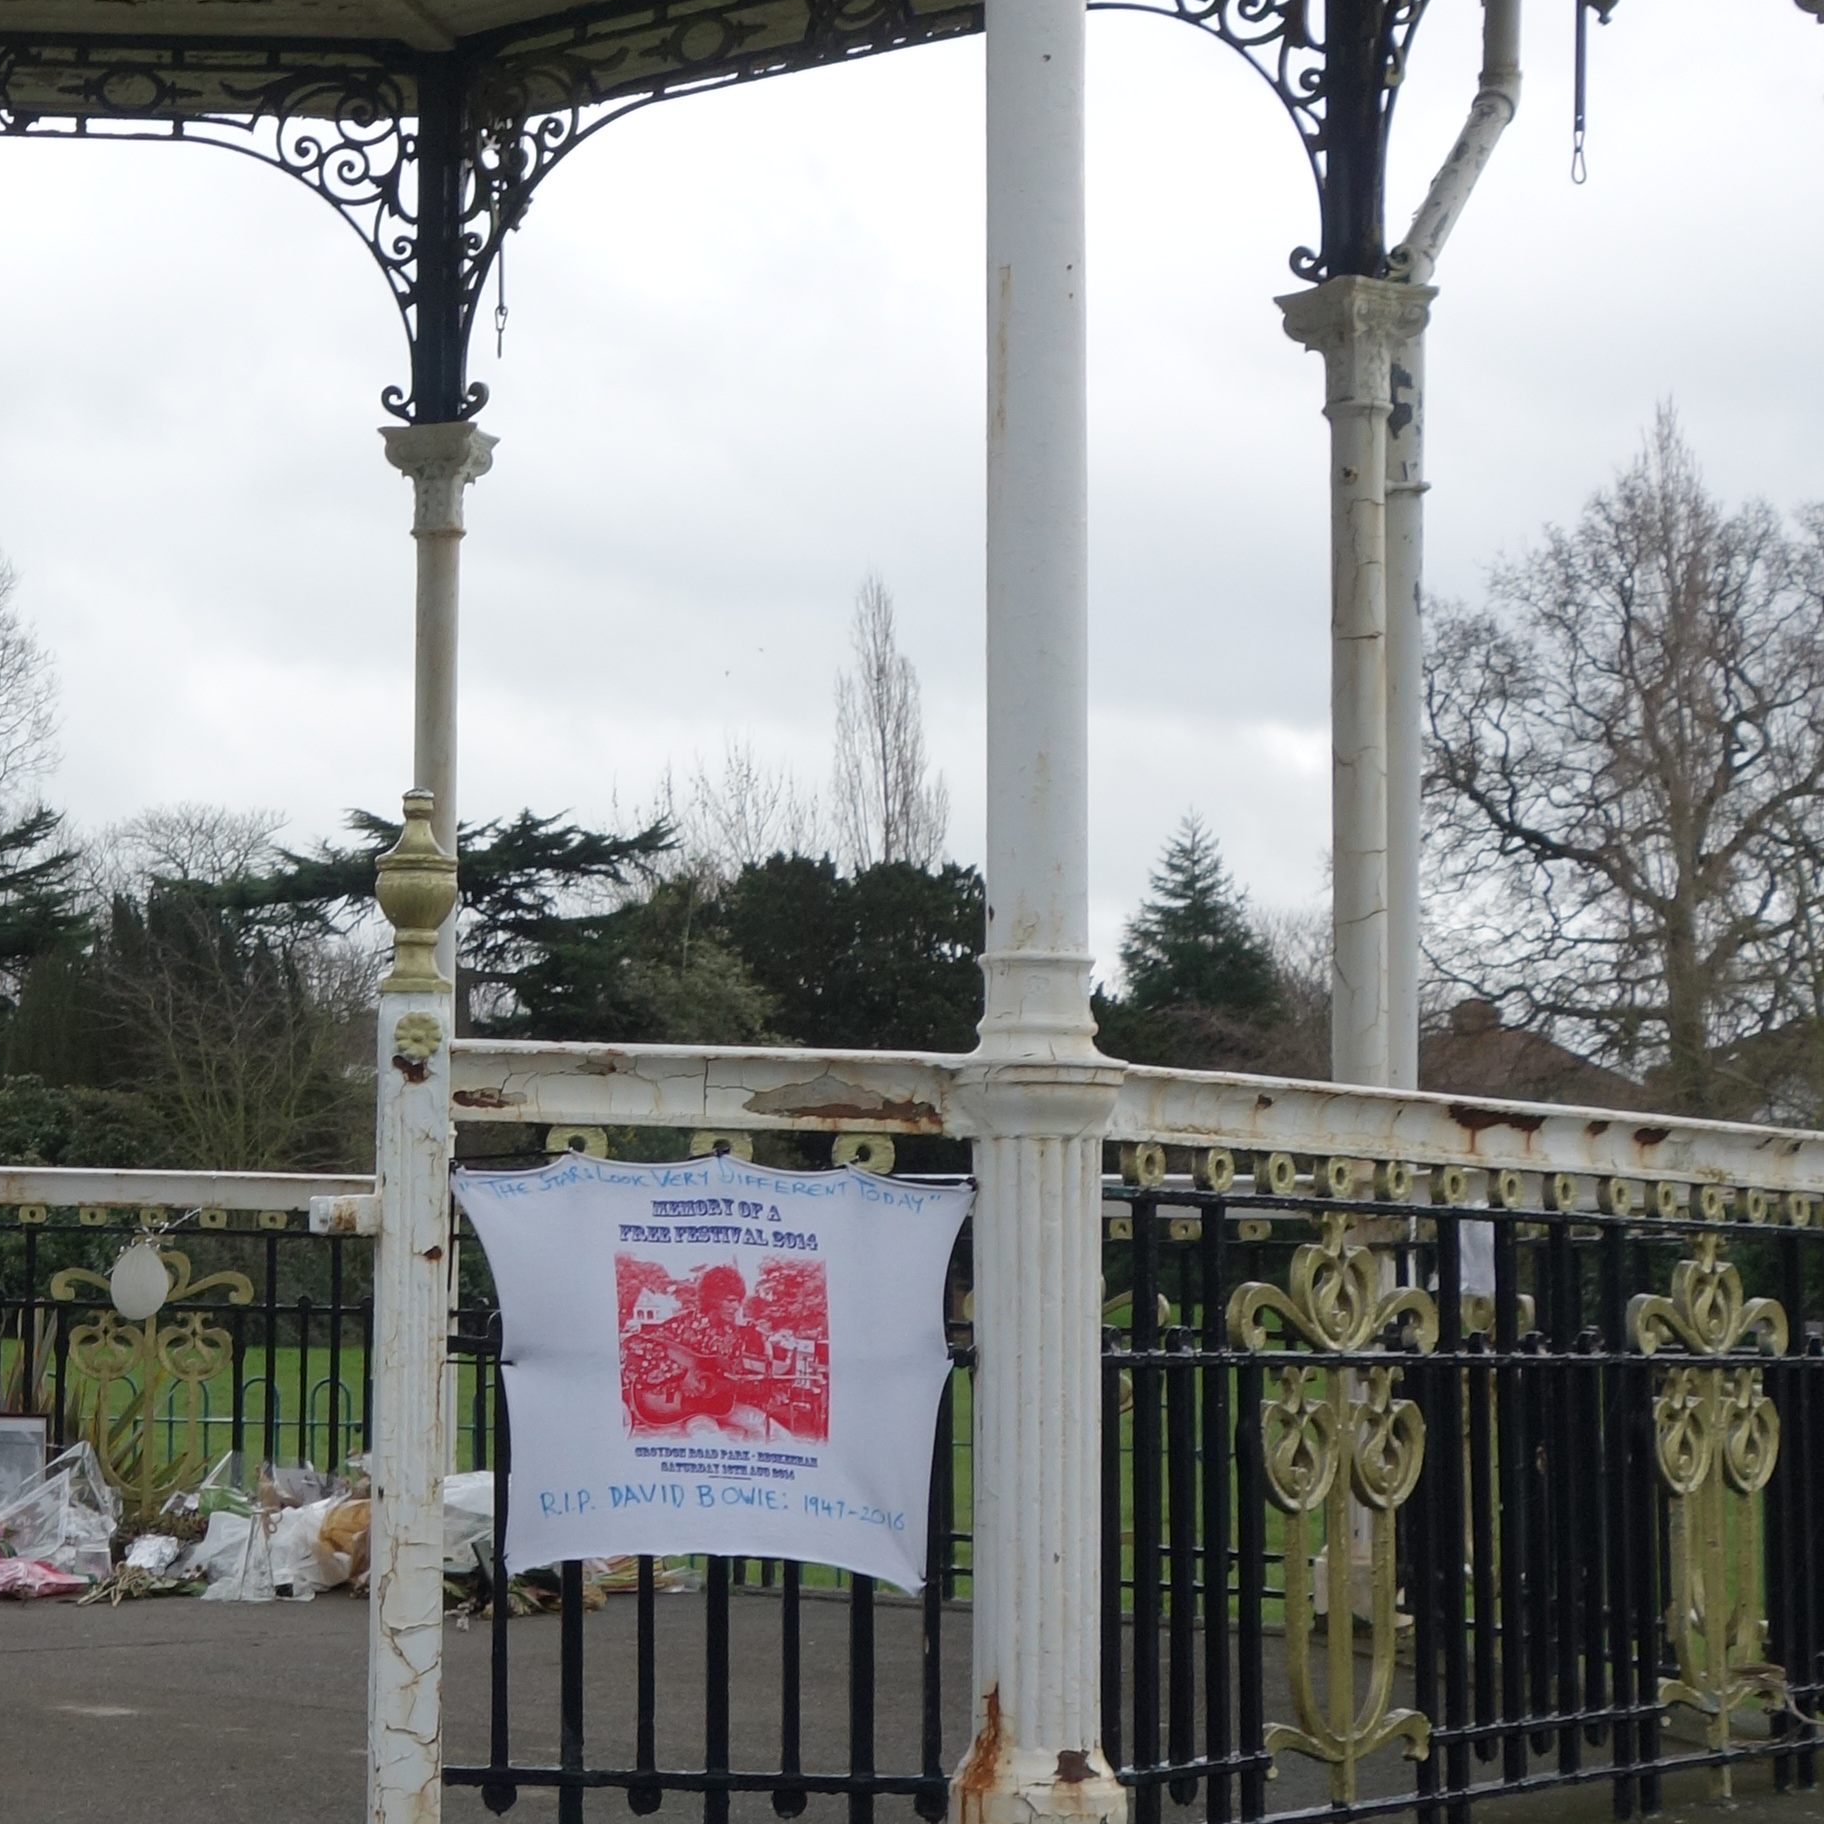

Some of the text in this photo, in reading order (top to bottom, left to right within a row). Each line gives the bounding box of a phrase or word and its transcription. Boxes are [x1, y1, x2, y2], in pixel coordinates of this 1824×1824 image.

[650, 1168, 708, 1188] VERY
[719, 1158, 847, 1196] DIFFERENT
[651, 1198, 782, 1222] MEMORY OF A
[619, 1224, 819, 1251] FREE FESTIVAL 2014
[687, 1448, 719, 1460] ROAD
[720, 1449, 751, 1461] PARK
[660, 1461, 720, 1474] SATURDAY
[540, 1489, 597, 1518] R.I.P.
[609, 1483, 685, 1508] DAVID
[695, 1484, 789, 1510] BOWIE:
